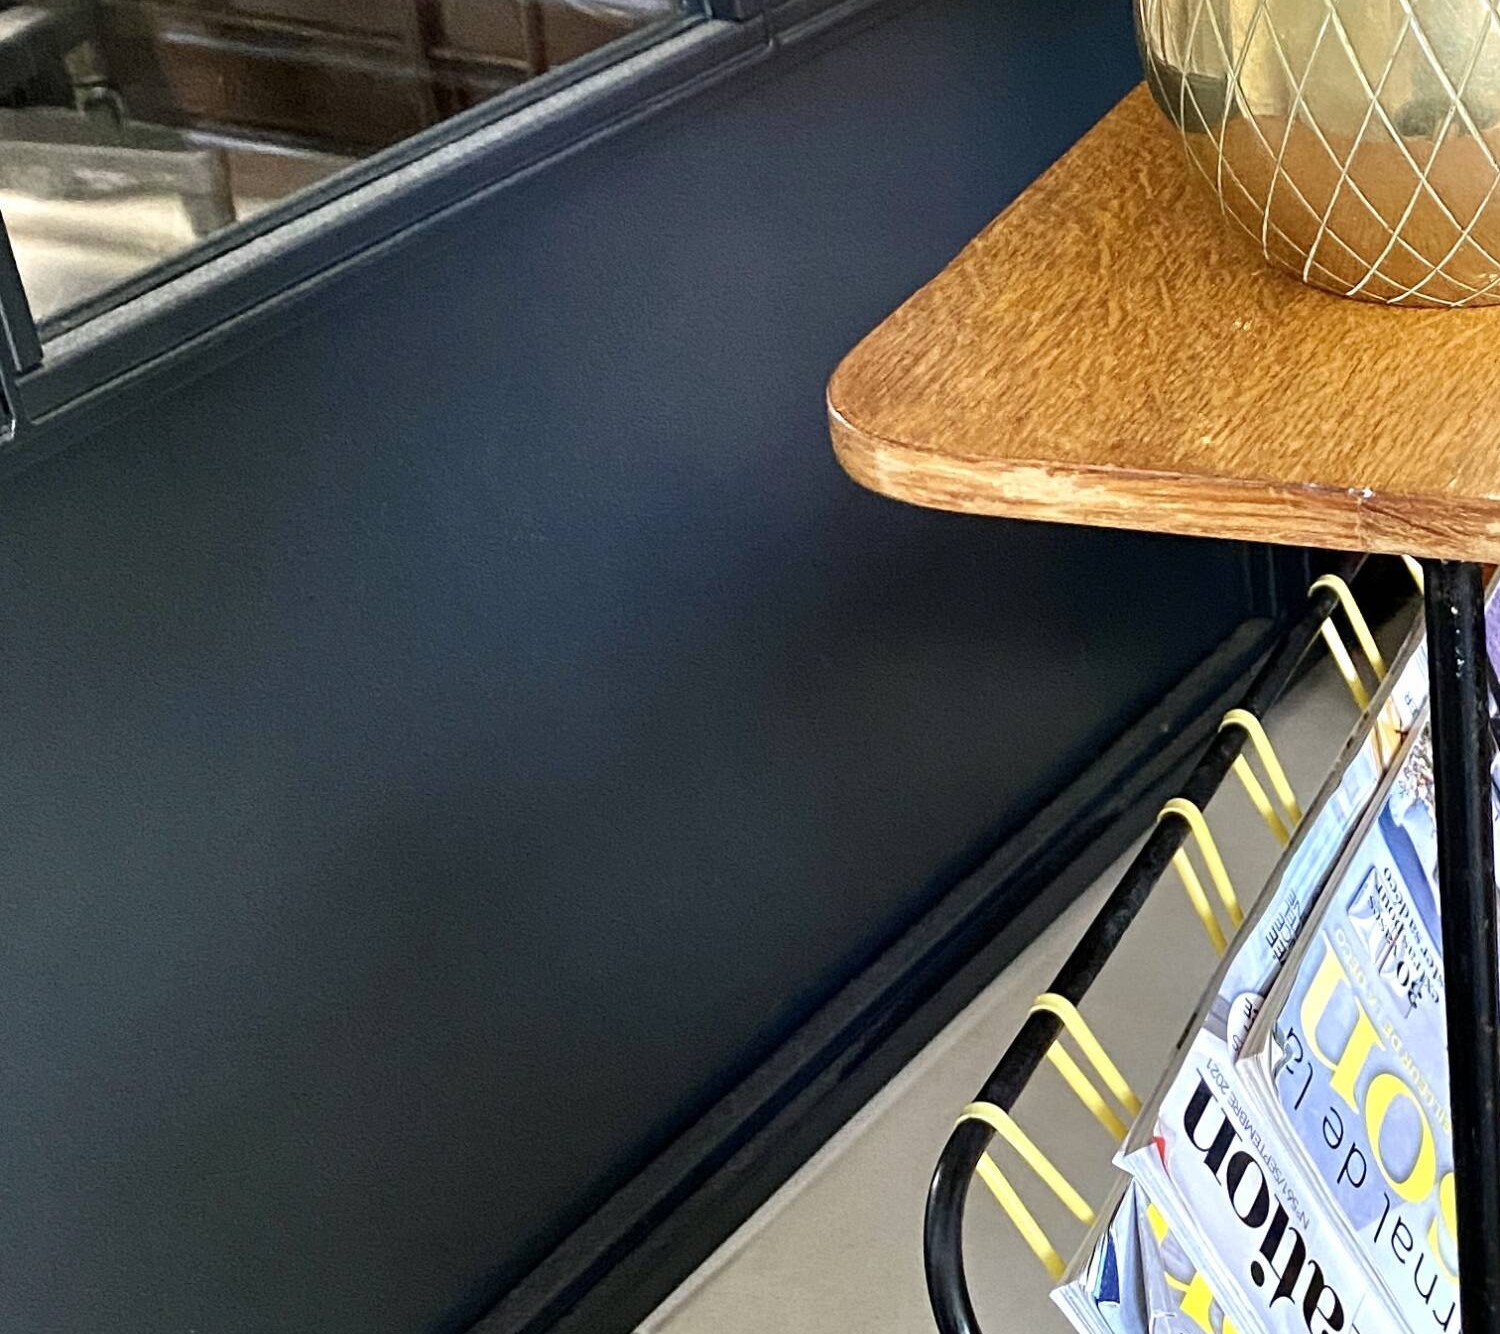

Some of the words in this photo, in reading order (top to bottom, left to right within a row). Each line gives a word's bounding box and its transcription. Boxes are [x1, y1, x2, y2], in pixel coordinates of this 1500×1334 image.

[1381, 866, 1411, 919] déco
[1363, 895, 1399, 957] vases
[1407, 917, 1425, 945] sa
[1396, 959, 1421, 1011] 30
[1398, 934, 1440, 1004] extras
[1419, 946, 1445, 985] ster
[1204, 1055, 1231, 1096] 2021
[1318, 1106, 1366, 1186] de
